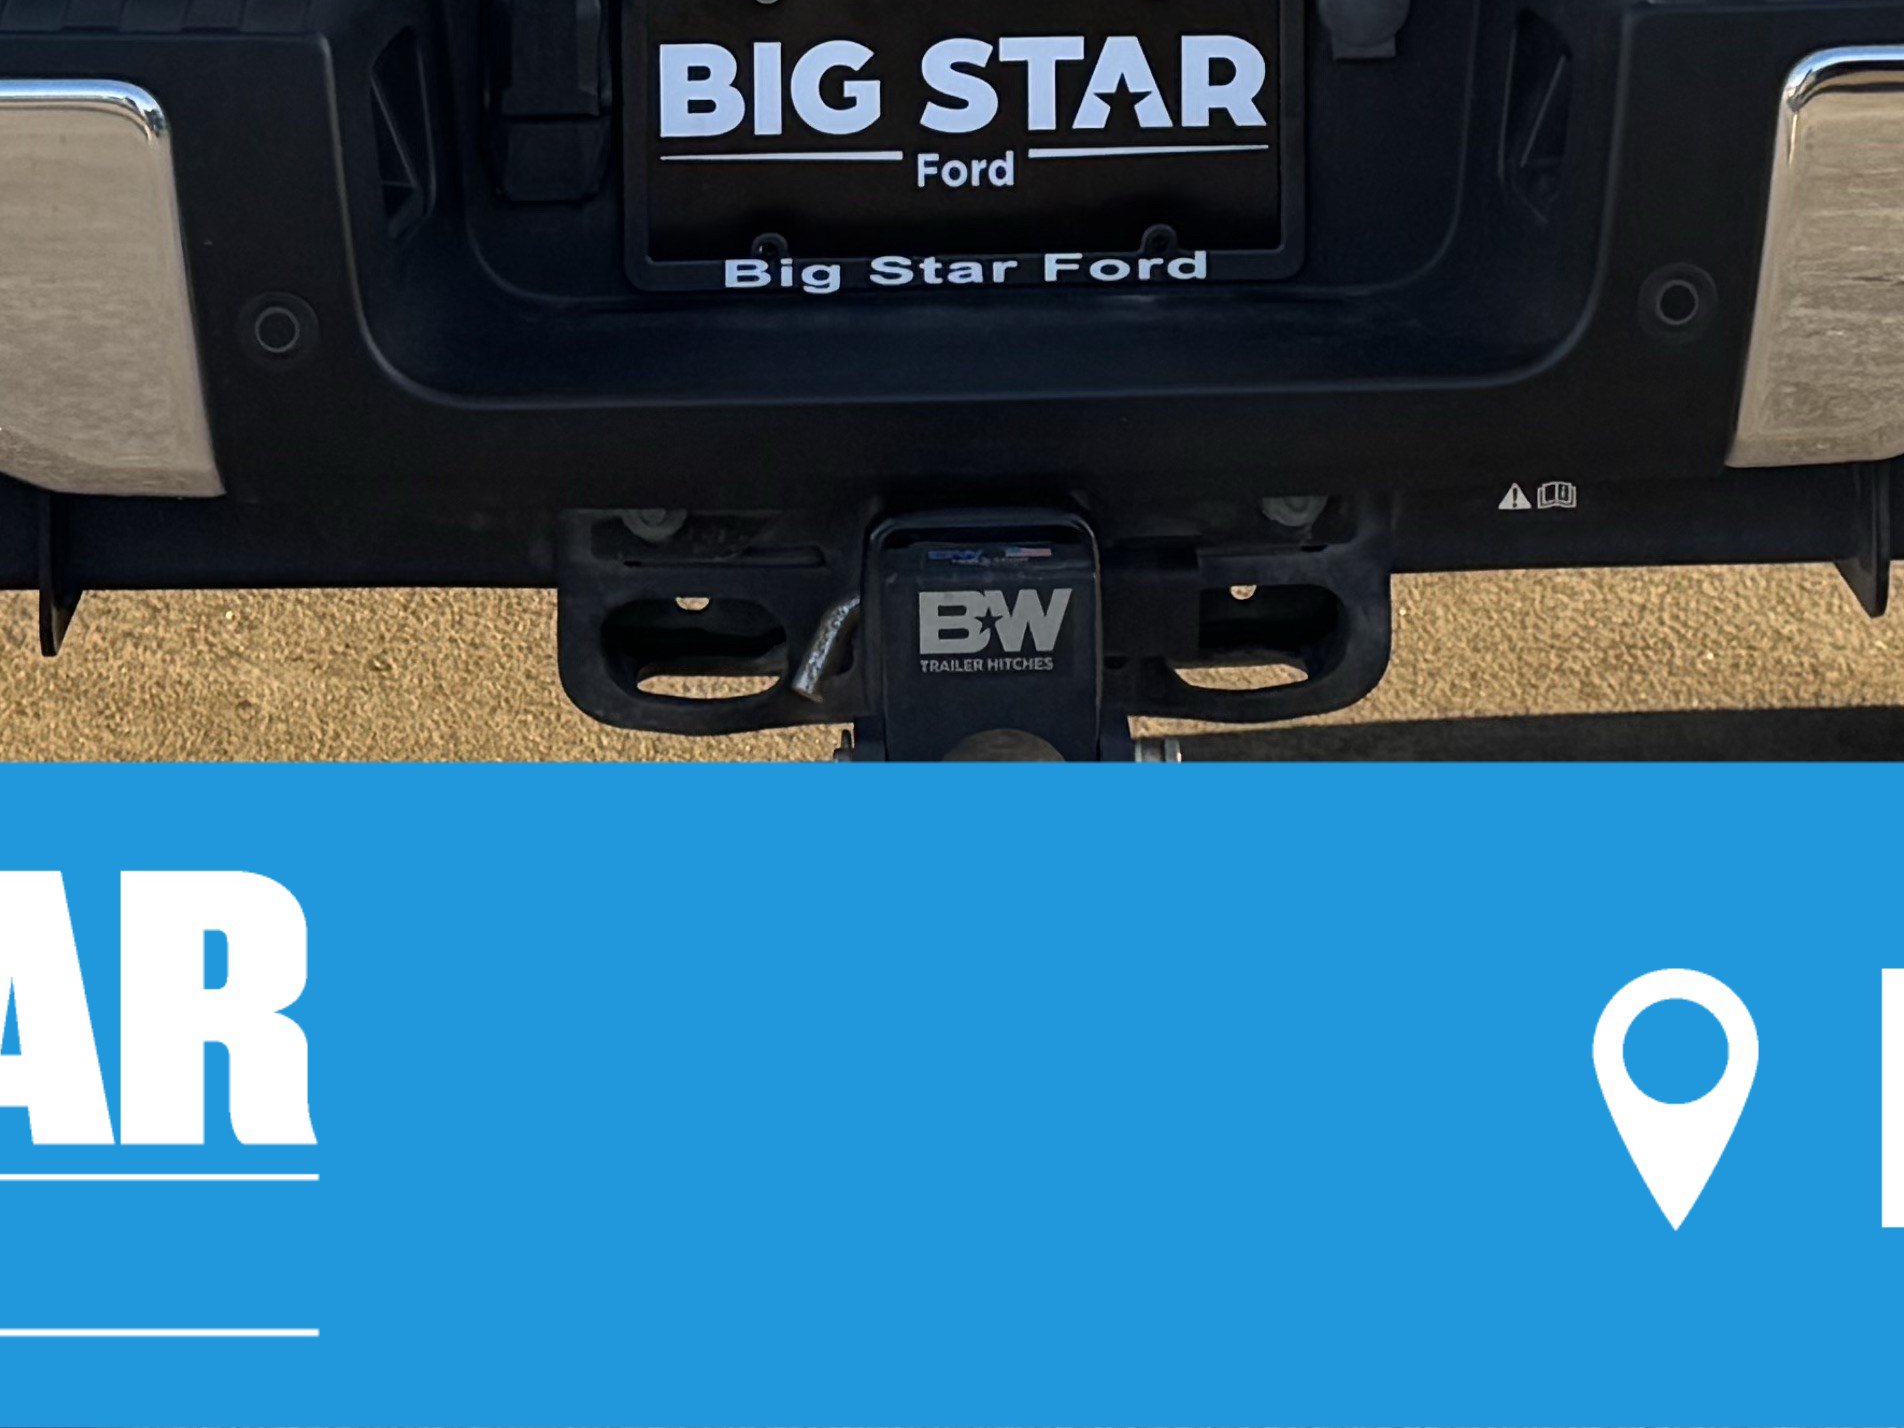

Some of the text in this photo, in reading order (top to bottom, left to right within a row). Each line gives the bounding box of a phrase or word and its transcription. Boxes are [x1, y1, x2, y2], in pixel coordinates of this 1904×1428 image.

[659, 34, 1267, 138] BIG STAR
[917, 150, 1015, 188] Ford
[724, 250, 1208, 294] Big Star Ford
[920, 657, 1054, 673] TRAILER HITCHES
